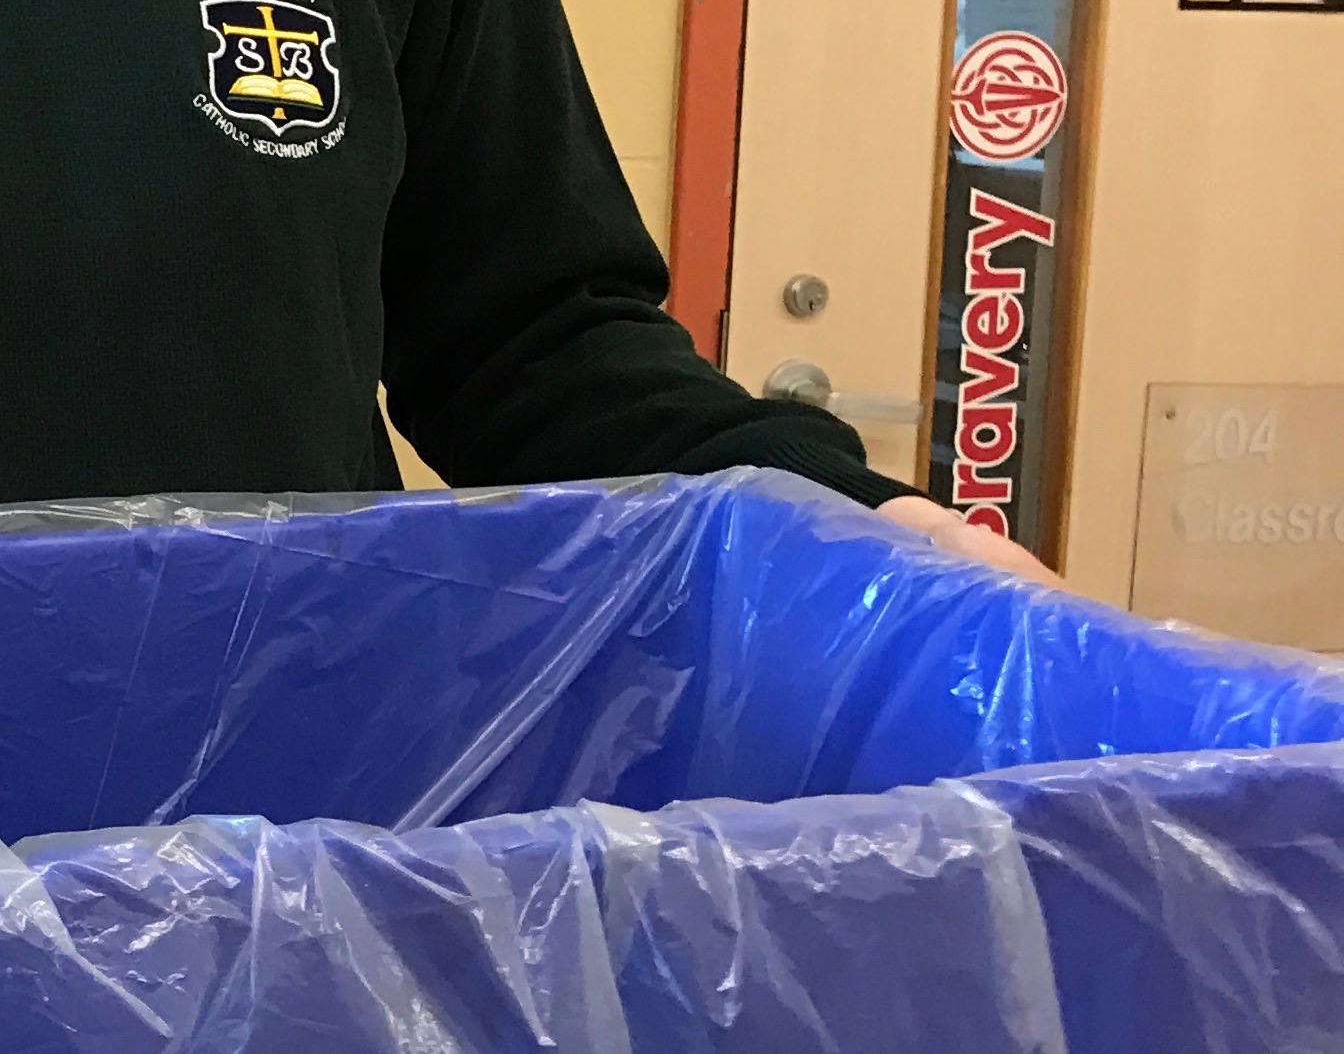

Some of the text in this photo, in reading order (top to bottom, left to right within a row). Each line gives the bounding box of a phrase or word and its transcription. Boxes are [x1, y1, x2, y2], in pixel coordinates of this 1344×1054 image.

[234, 37, 313, 80] S B
[192, 93, 249, 147] CATHOLIC
[1182, 406, 1280, 462] 204
